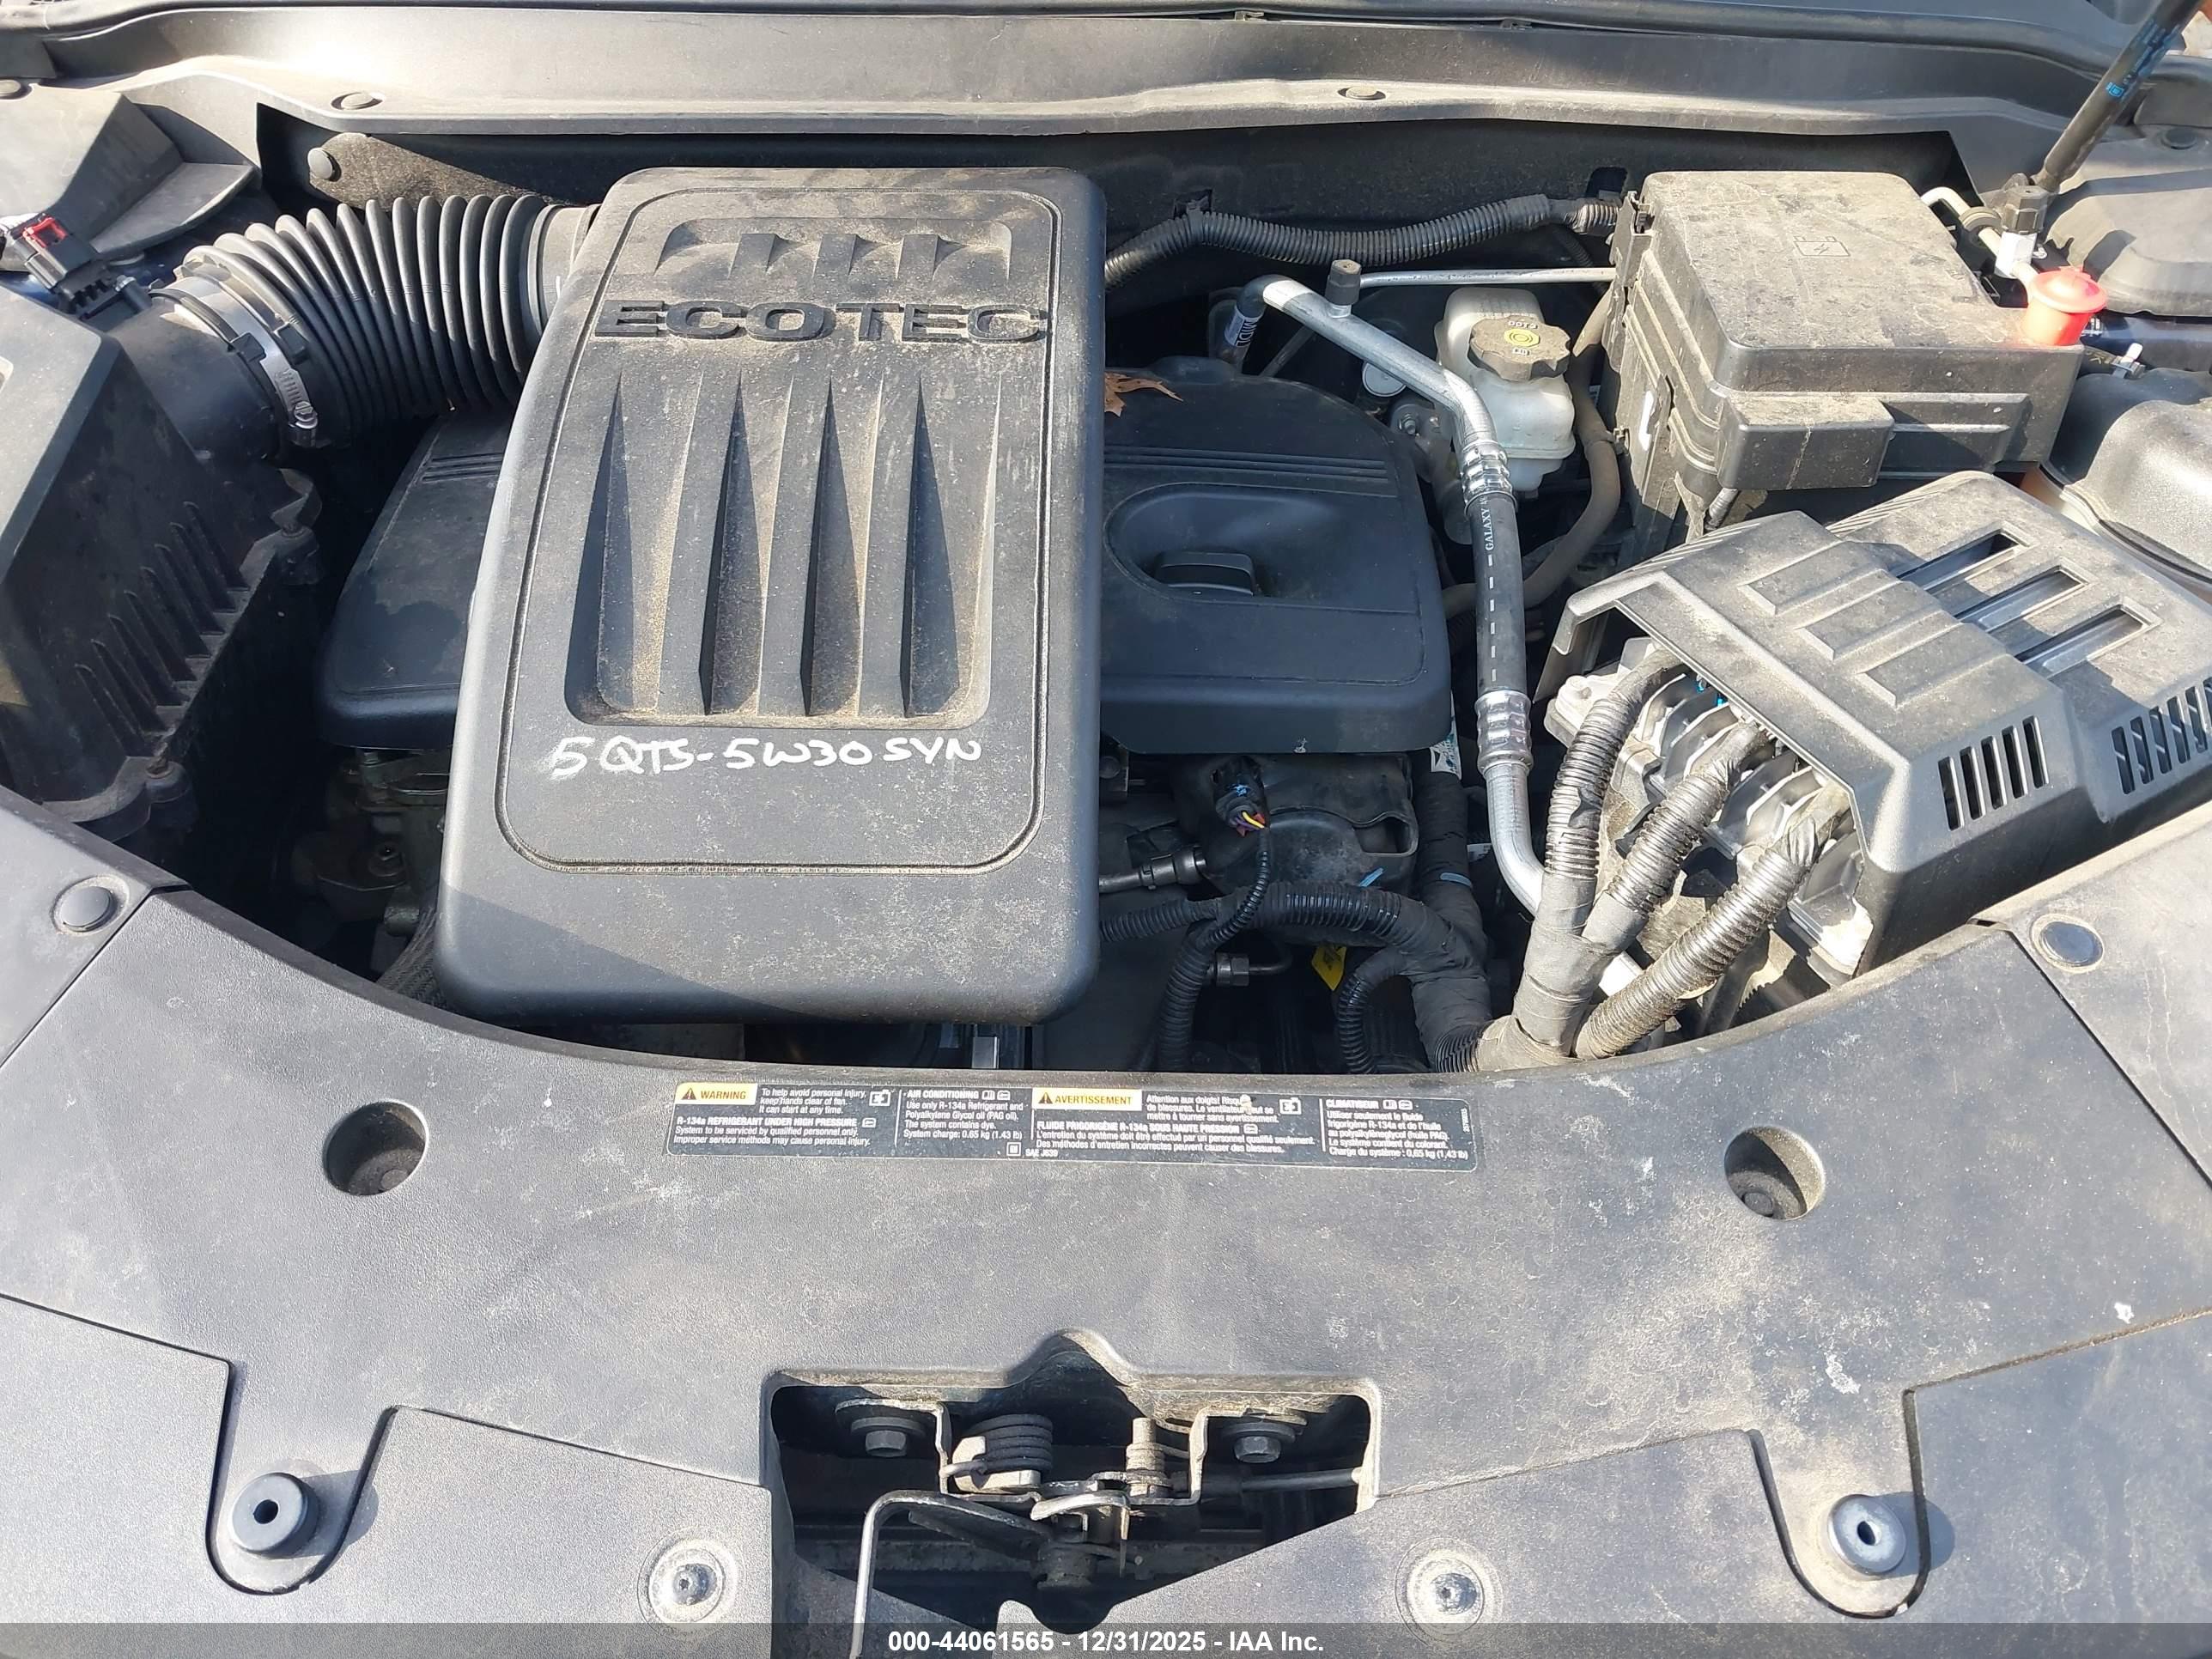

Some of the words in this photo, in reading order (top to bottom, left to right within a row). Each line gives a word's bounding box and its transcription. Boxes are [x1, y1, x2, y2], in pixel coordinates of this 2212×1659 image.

[594, 301, 1048, 343] ECOTEC
[1480, 507, 1494, 551] GALAXY
[550, 735, 592, 780] 5
[883, 738, 981, 764] SYN
[700, 1091, 746, 1100] WARNING
[761, 1088, 770, 1097] To
[772, 1088, 788, 1098] help
[789, 1089, 810, 1097] avoid
[811, 1090, 842, 1099] personal
[907, 1090, 921, 1099] AIR
[922, 1091, 979, 1100] CONDITIONING
[1054, 1095, 1133, 1105] AVERTISSEMENT
[906, 1102, 921, 1110] Use
[921, 1102, 938, 1111] only
[968, 1103, 1009, 1112] Refrigerant
[1010, 1103, 1023, 1111] and
[707, 1117, 763, 1126] REFRIGERANT
[764, 1117, 793, 1127] UNDER
[793, 1118, 814, 1127] HIGH
[815, 1118, 858, 1127] PRESSURE
[905, 1120, 919, 1129] The
[920, 1121, 946, 1131] system
[947, 1121, 980, 1129] contains
[675, 1125, 703, 1135] System
[726, 1127, 757, 1135] serviced
[758, 1127, 769, 1137] by
[770, 1127, 803, 1137] qualified
[803, 1128, 840, 1138] personnel
[903, 1130, 932, 1139] System
[962, 1130, 980, 1139] 0.65
[981, 1131, 990, 1140] kg
[1076, 1131, 1086, 1139] du
[673, 1135, 708, 1146] Improper
[708, 1136, 737, 1145] service
[738, 1136, 771, 1145] methods
[772, 1137, 789, 1146] may
[814, 1138, 847, 1146] personal
